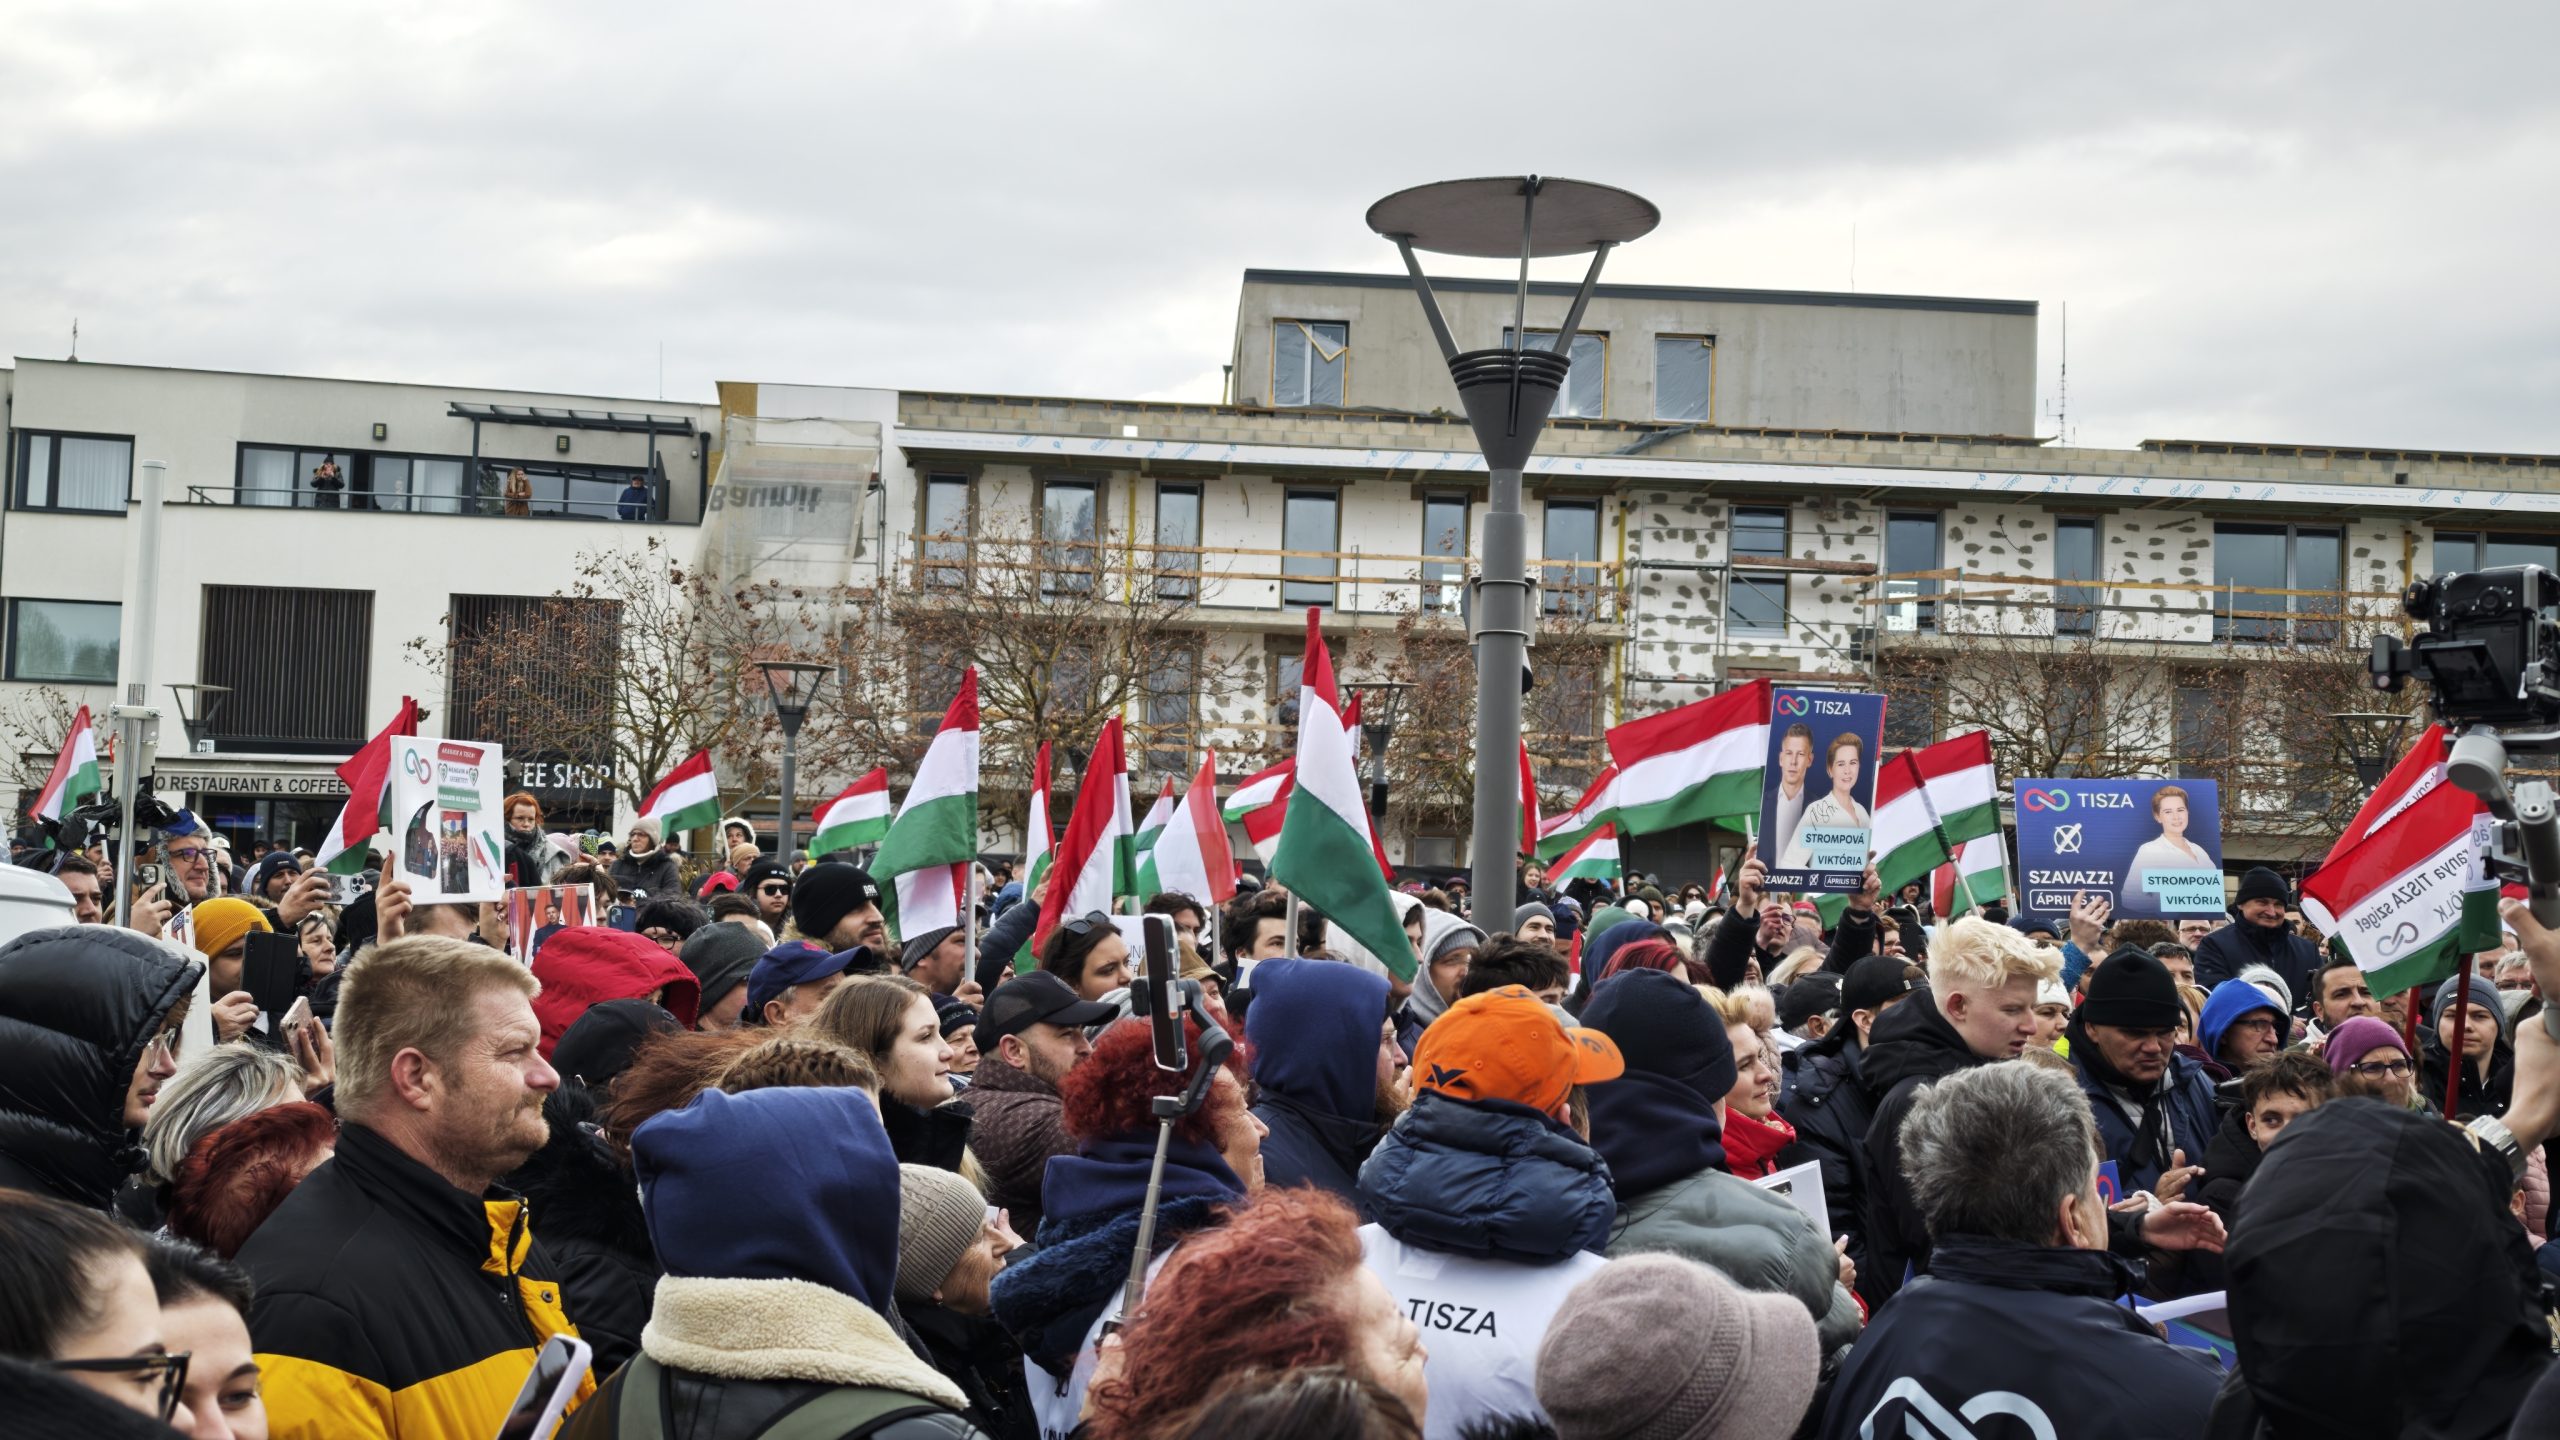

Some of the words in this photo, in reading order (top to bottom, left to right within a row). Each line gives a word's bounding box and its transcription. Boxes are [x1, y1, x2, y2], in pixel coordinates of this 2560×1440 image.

[1814, 700, 1852, 716] TISZA
[170, 776, 270, 793] RESTAURANT
[273, 778, 283, 793] &
[288, 778, 347, 794] COFFEE
[2076, 793, 2135, 809] TISZA
[1805, 831, 1865, 845] STROMPOVÁ
[1818, 853, 1863, 866] VIKTÓRIA
[1763, 874, 1803, 885] ZAVAZZ!
[1826, 876, 1850, 885] ÁPRILIS
[2029, 870, 2114, 885] SZAVAZZ!
[2148, 874, 2221, 886] STROMPOVÁ
[2036, 892, 2088, 905] ÁPRILS
[2165, 895, 2222, 906] VIKTÓRIA
[1408, 1298, 1497, 1338] TISZA
